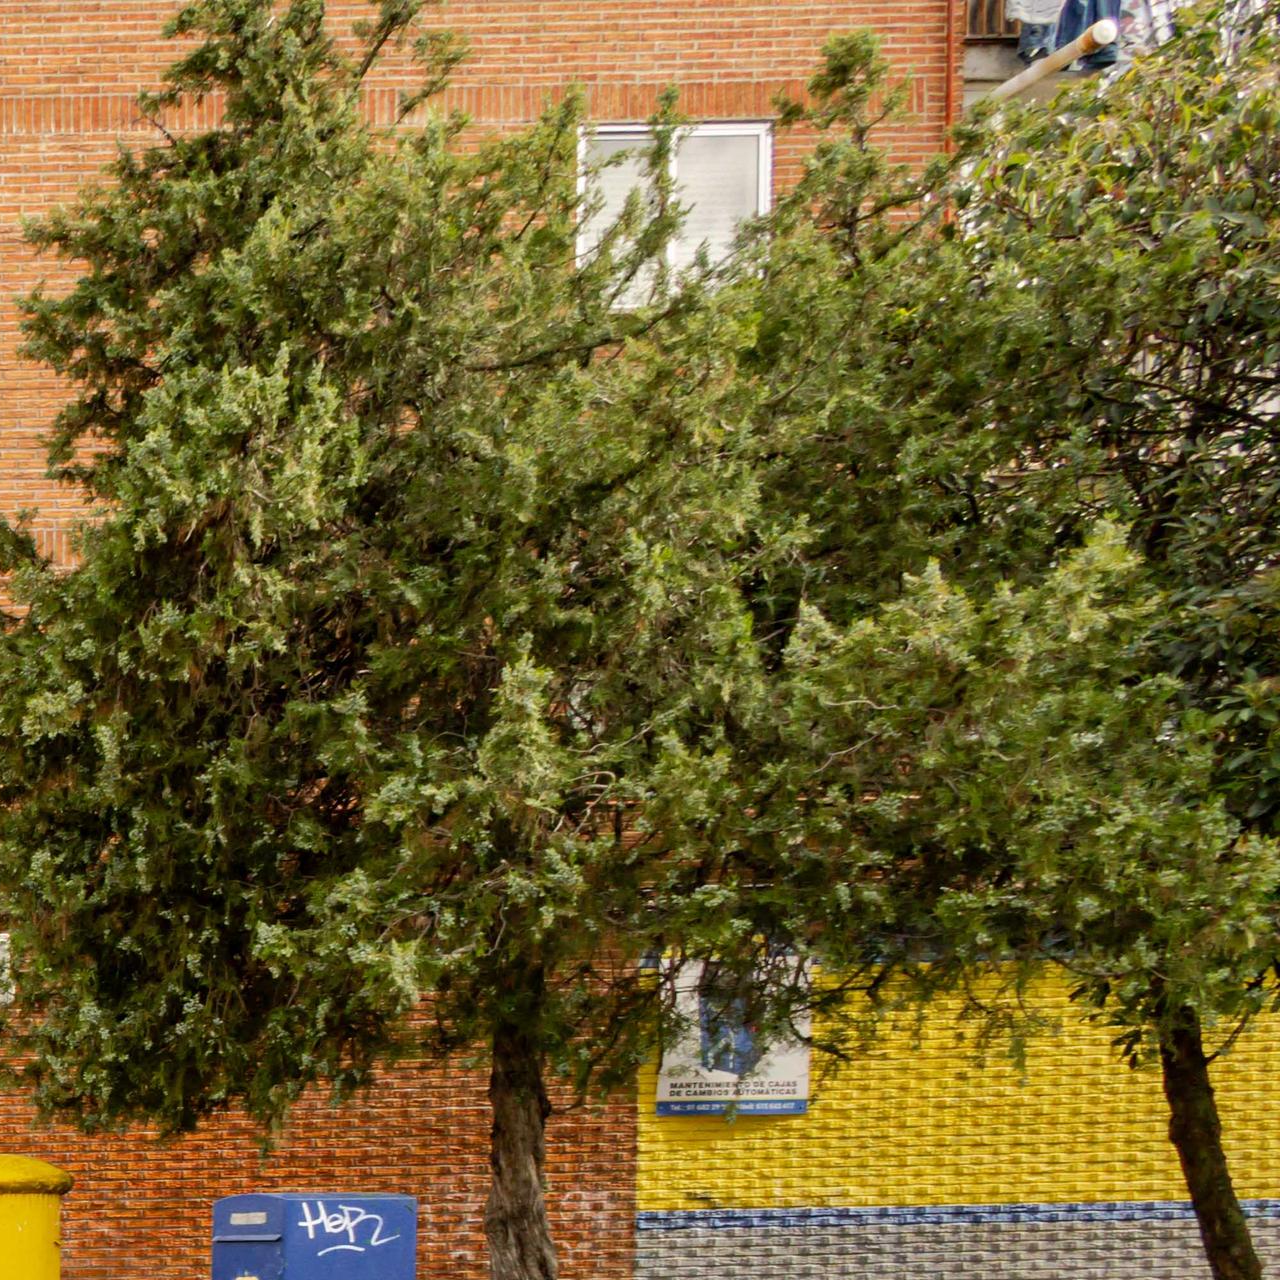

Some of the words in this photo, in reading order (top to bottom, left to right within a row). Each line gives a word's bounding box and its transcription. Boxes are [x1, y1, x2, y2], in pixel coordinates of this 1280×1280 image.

[753, 1080, 765, 1088] DE
[768, 1080, 797, 1088] CAJAS
[669, 1089, 682, 1097] DE
[685, 1089, 729, 1097] CAMBIOS
